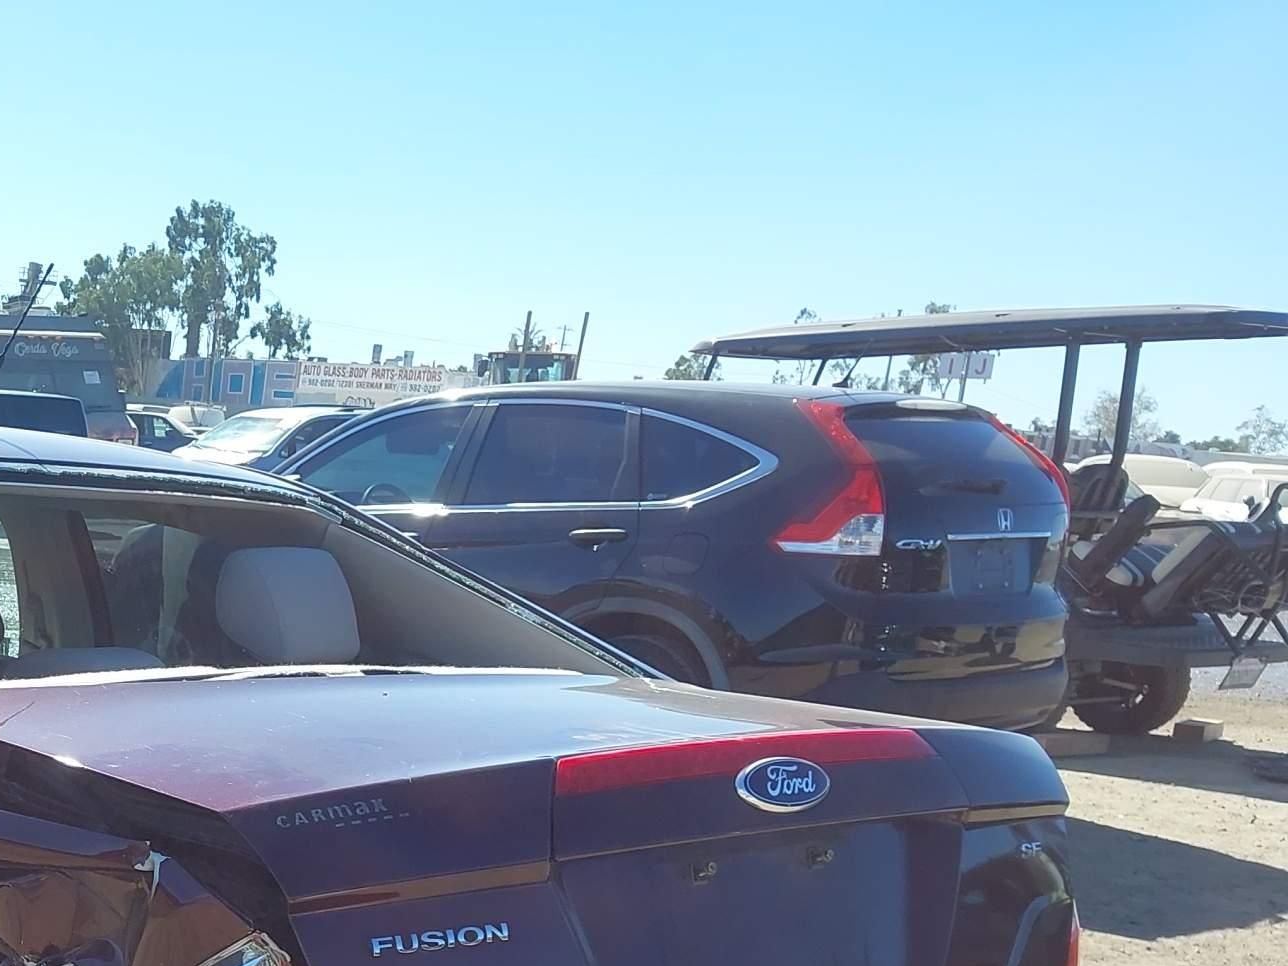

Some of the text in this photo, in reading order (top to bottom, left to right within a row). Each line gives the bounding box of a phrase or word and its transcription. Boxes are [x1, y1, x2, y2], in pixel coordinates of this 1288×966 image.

[303, 364, 322, 377] AUTO
[975, 357, 987, 375] J
[767, 765, 816, 797] Ford
[370, 922, 510, 957] FUSION
